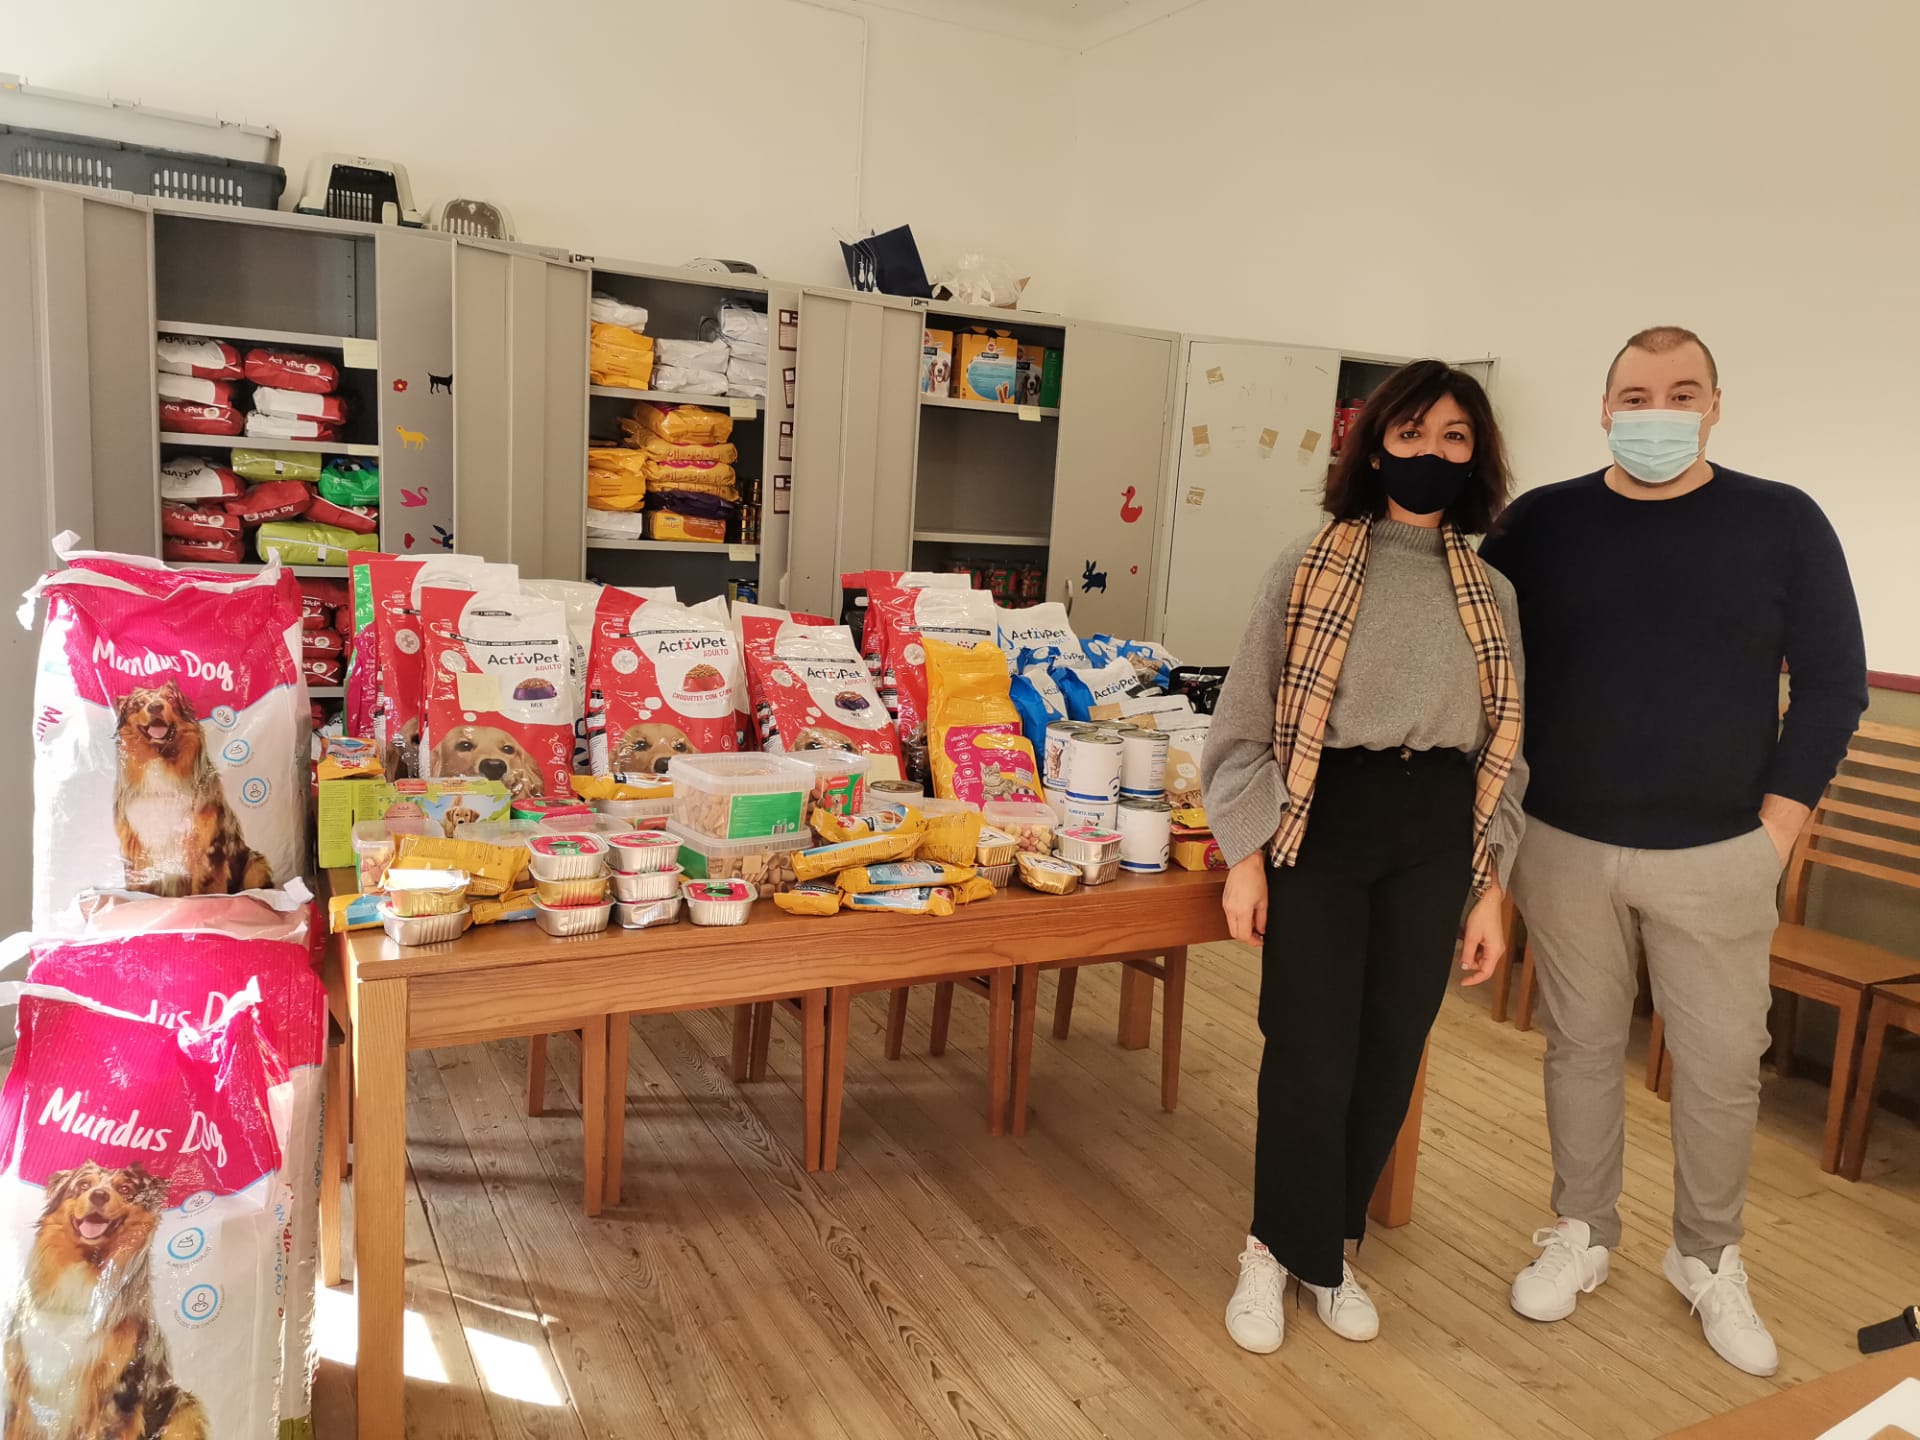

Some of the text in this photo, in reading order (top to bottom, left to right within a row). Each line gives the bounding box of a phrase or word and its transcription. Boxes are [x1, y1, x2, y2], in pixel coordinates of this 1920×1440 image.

[92, 635, 234, 692] Mundus Dog
[38, 1086, 228, 1168] Mundus Dog
